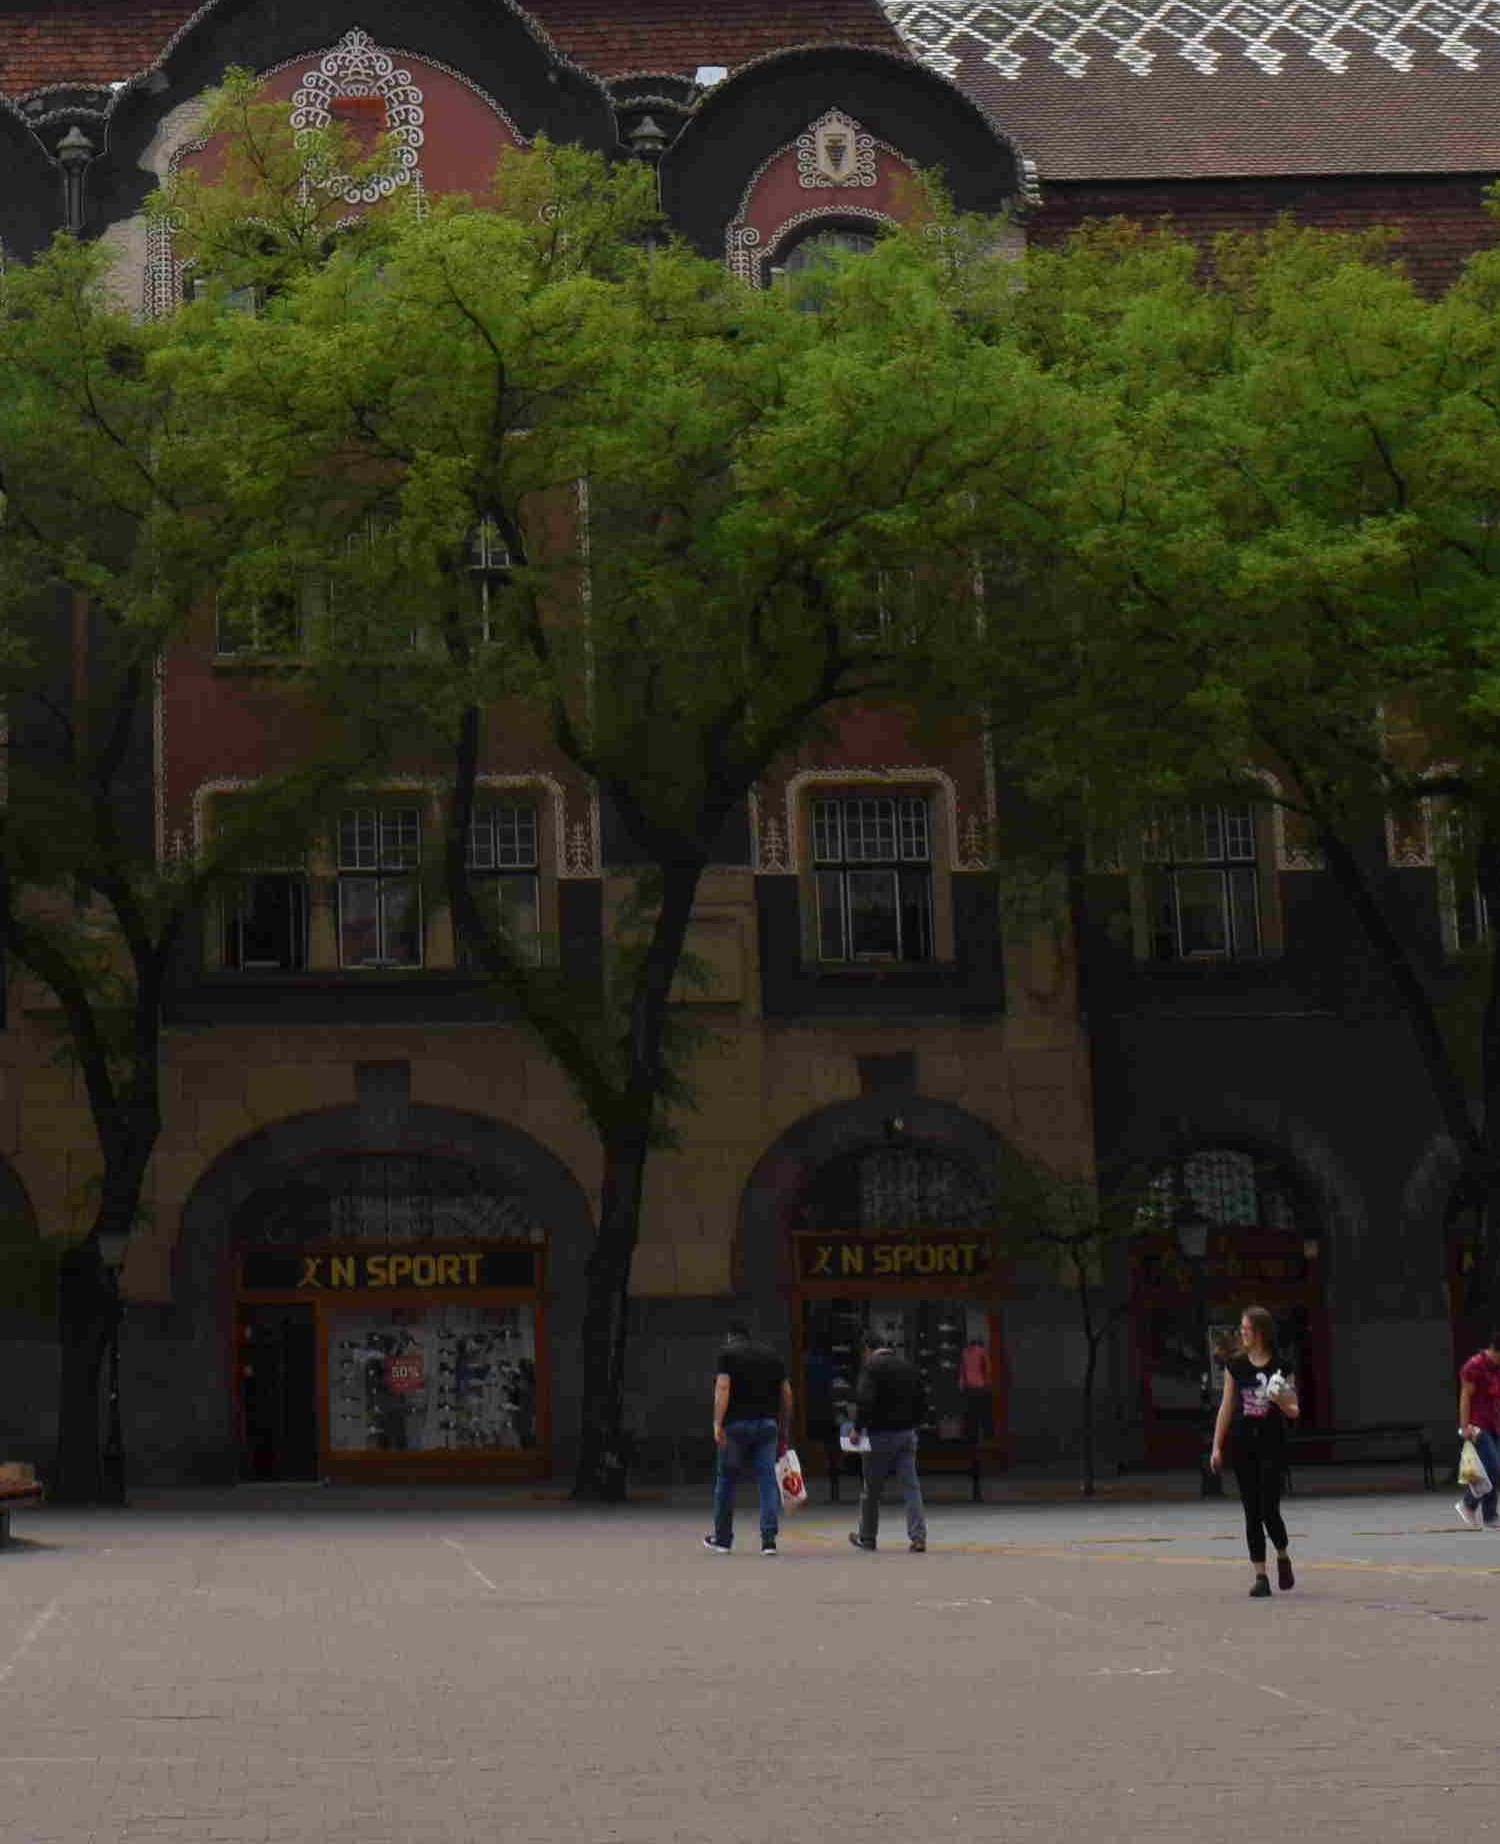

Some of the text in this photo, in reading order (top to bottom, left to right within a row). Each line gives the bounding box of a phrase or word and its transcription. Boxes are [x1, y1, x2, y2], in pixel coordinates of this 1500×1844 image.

[331, 1252, 485, 1285] N SPORT
[841, 1244, 979, 1274] N SPORT
